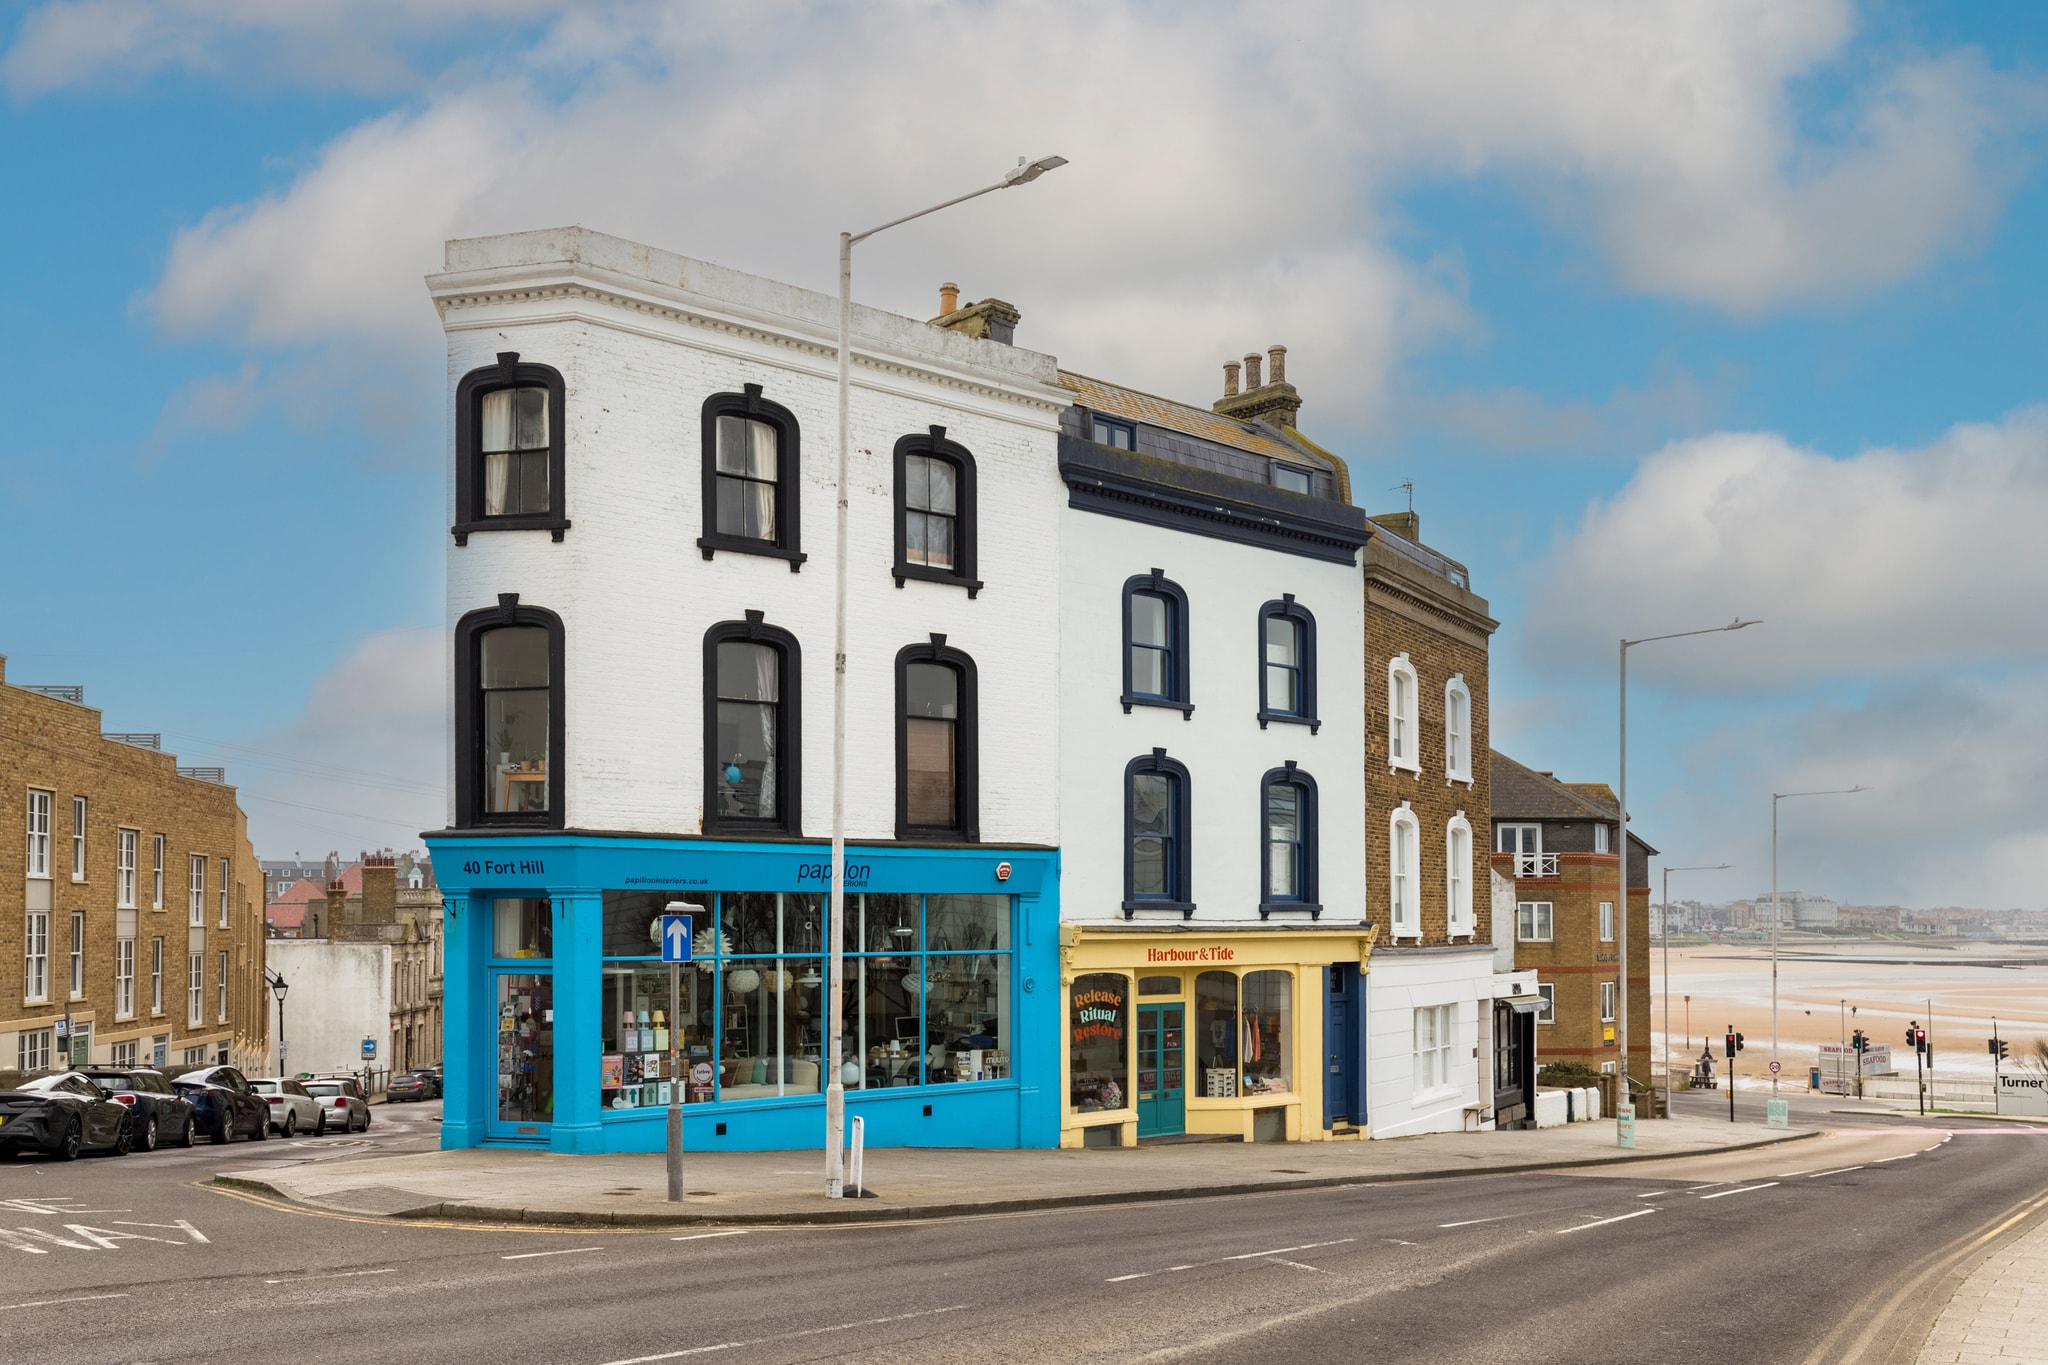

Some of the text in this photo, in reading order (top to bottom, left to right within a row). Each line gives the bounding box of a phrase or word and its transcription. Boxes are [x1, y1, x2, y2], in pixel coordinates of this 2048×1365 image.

[463, 860, 545, 874] 40 Fort Hill
[797, 860, 870, 884] paplon
[625, 876, 709, 885] papilloninteriors.co.uk
[1074, 989, 1122, 1008] Release
[1080, 1006, 1117, 1024] Ritual
[1073, 1024, 1121, 1042] Restore
[1999, 1075, 2045, 1088] Turner
